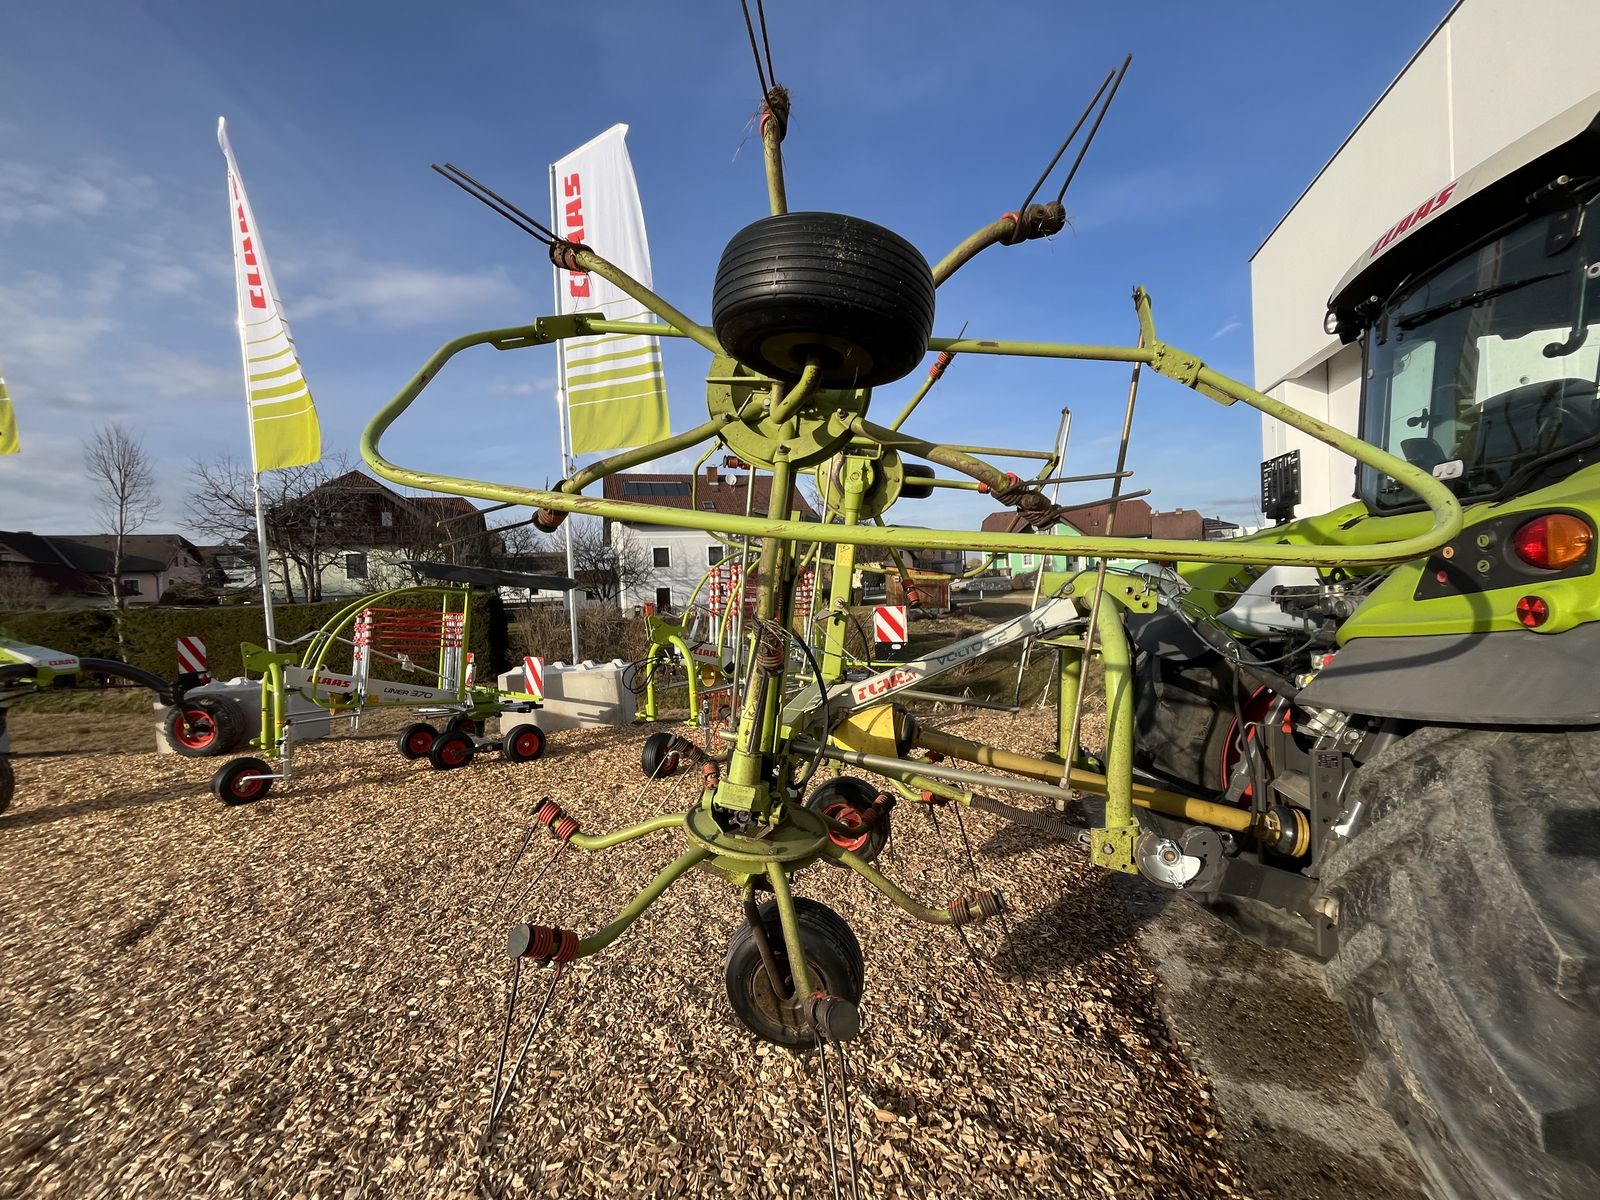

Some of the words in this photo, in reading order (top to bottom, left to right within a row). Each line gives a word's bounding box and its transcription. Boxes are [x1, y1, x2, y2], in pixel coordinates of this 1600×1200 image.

[563, 172, 591, 298] CAAS
[1369, 181, 1458, 259] CLAAS
[383, 687, 410, 696] LINER
[410, 690, 434, 699] 370
